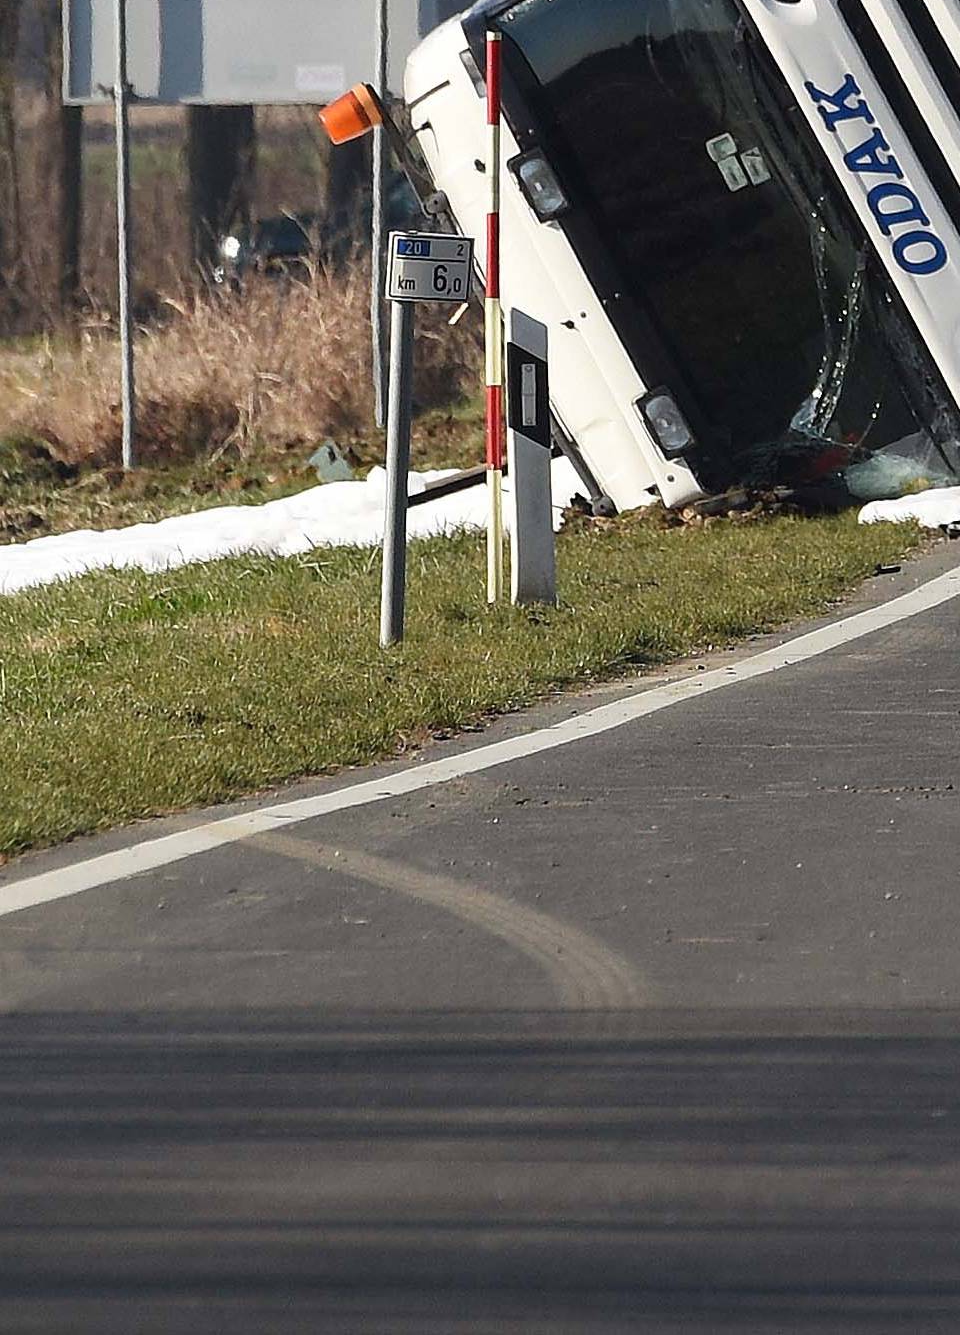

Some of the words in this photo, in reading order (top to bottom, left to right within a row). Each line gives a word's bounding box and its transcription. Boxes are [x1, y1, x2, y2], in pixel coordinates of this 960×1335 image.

[804, 73, 948, 275] ODAK
[405, 241, 422, 255] 20
[456, 244, 464, 257] 2
[397, 276, 416, 290] km
[433, 264, 462, 295] 6,0
